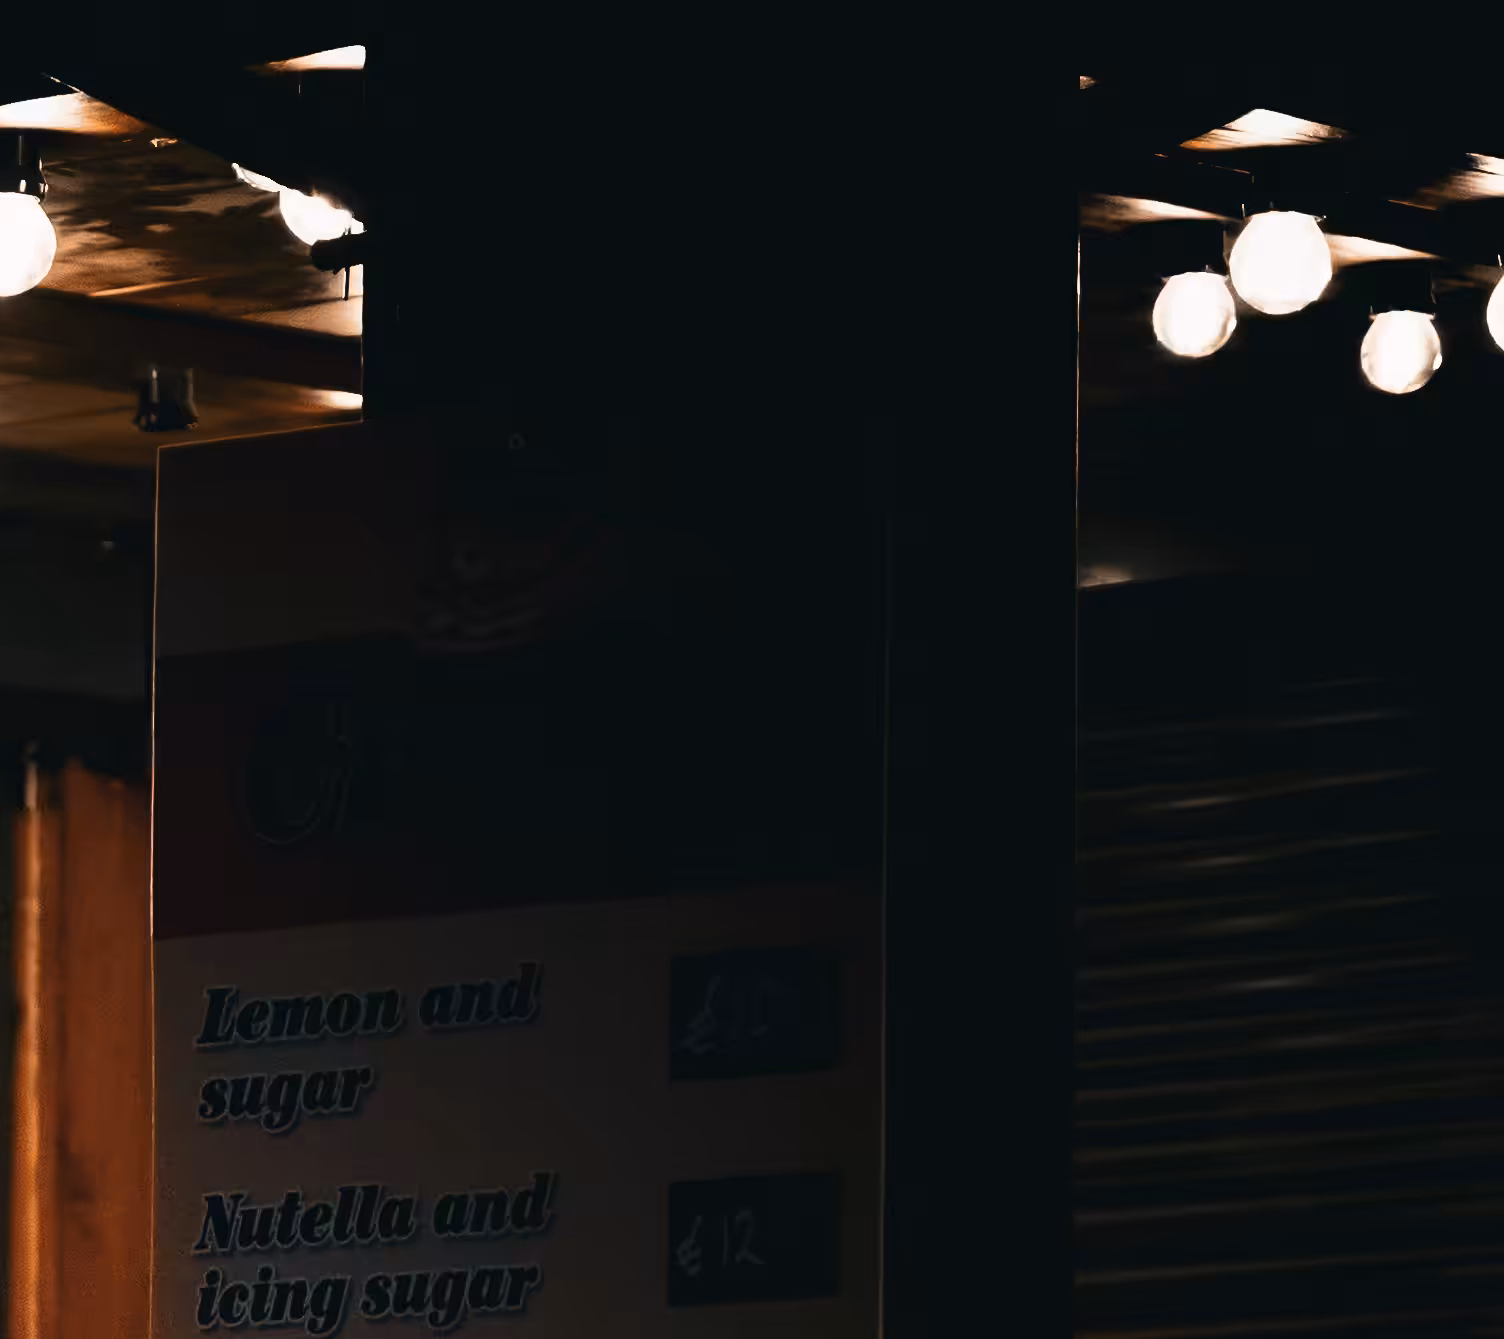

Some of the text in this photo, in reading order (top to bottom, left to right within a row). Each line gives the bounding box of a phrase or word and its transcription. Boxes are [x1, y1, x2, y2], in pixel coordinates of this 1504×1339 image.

[193, 962, 542, 1048] Lemon and
[197, 1060, 375, 1130] sugar
[192, 1171, 556, 1255] Nutella and
[195, 1261, 542, 1336] icing sugar
